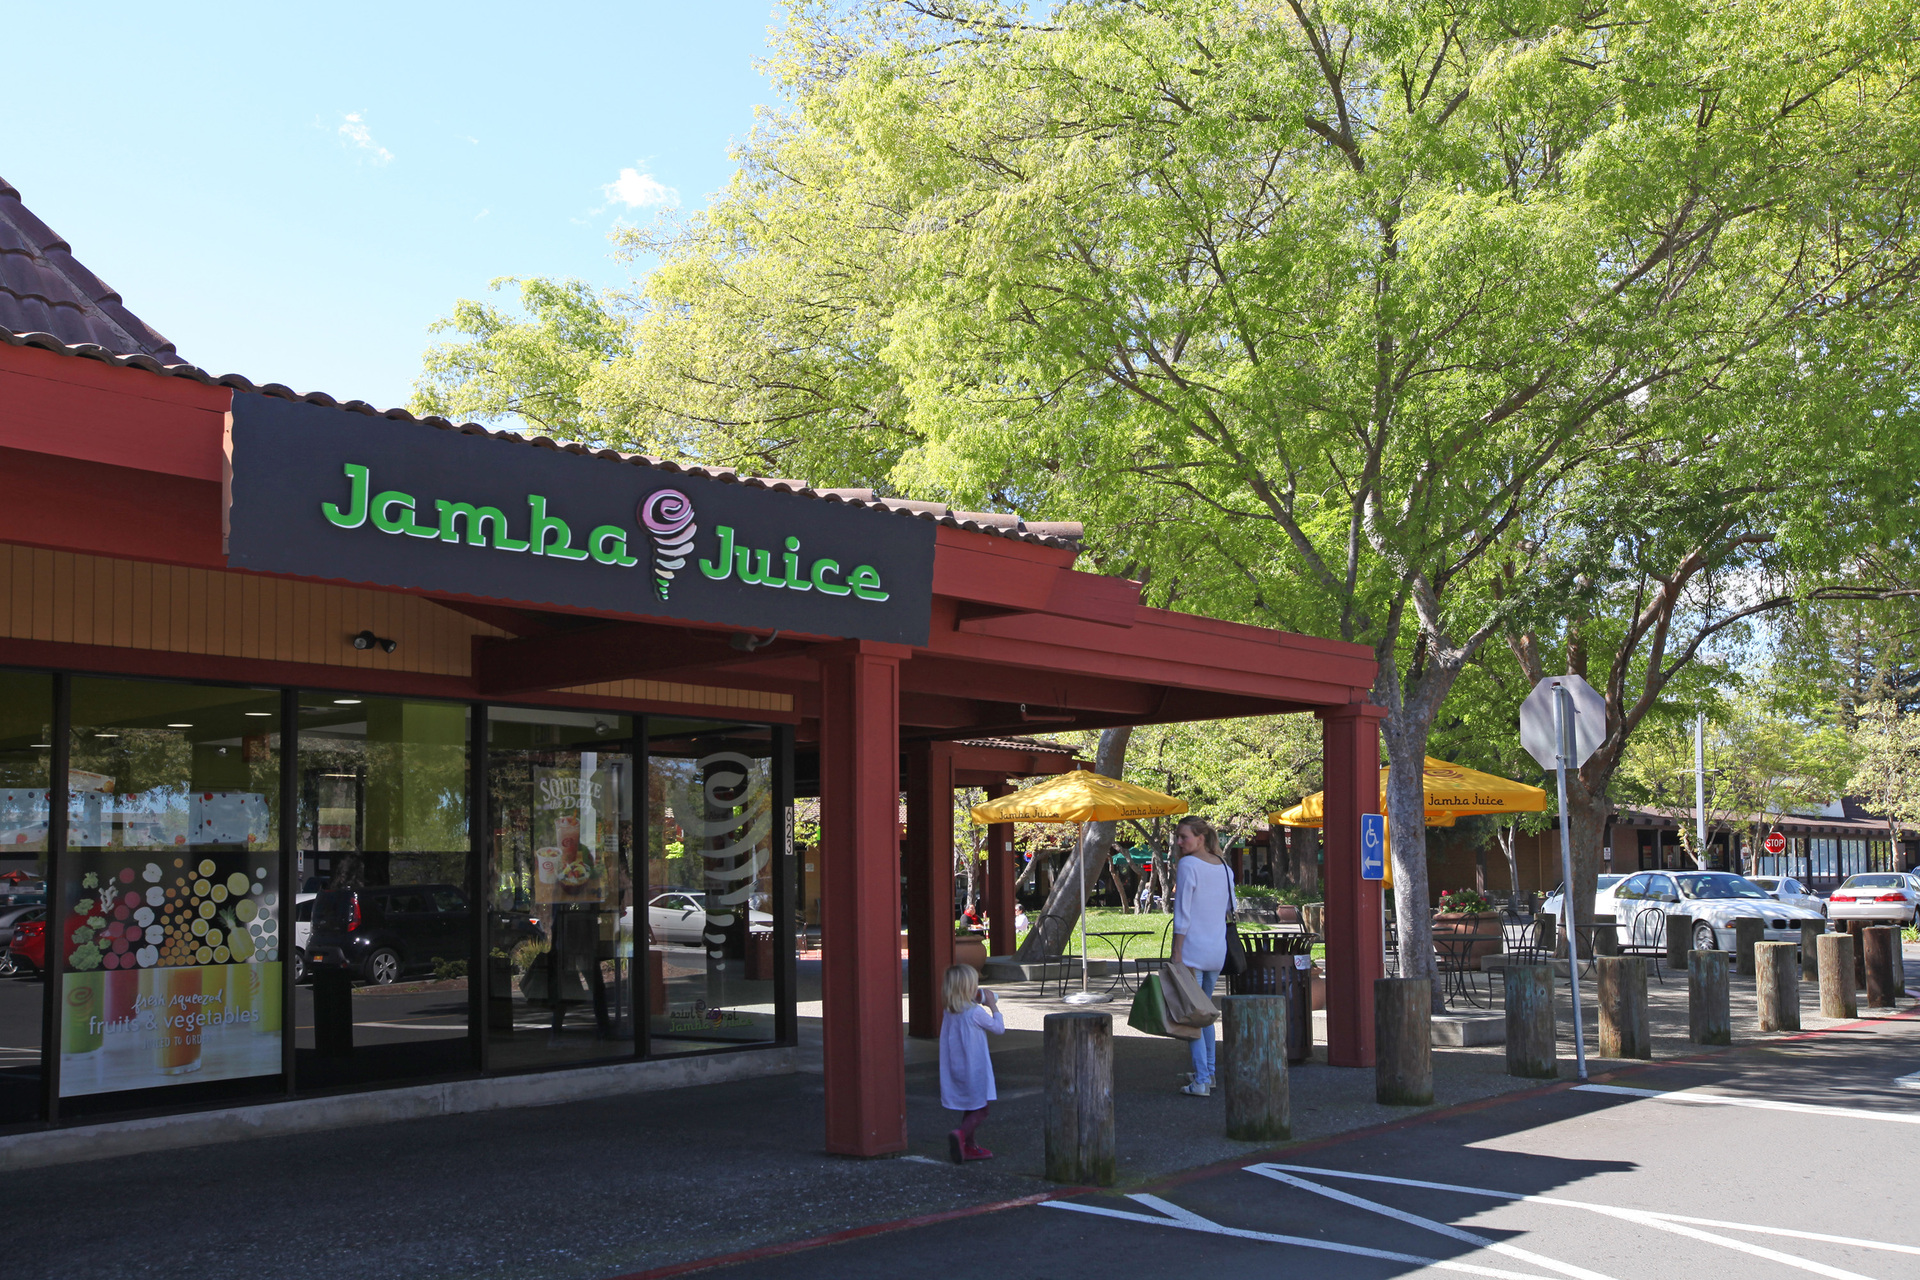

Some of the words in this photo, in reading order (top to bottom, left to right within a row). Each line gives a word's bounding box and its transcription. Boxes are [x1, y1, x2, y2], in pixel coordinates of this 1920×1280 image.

[322, 463, 638, 567] Jamba
[699, 525, 889, 601] Juice
[540, 777, 602, 802] SQUEEZE
[1428, 793, 1470, 805] Jamba
[1472, 793, 1504, 805] Juice
[562, 796, 593, 816] Day
[785, 807, 793, 854] 623
[1766, 838, 1784, 848] STOP
[131, 993, 166, 1014] fresh
[168, 989, 223, 1011] squeezed
[89, 1015, 140, 1035] fruits
[145, 1013, 158, 1031] &
[164, 1005, 259, 1032] vegetables
